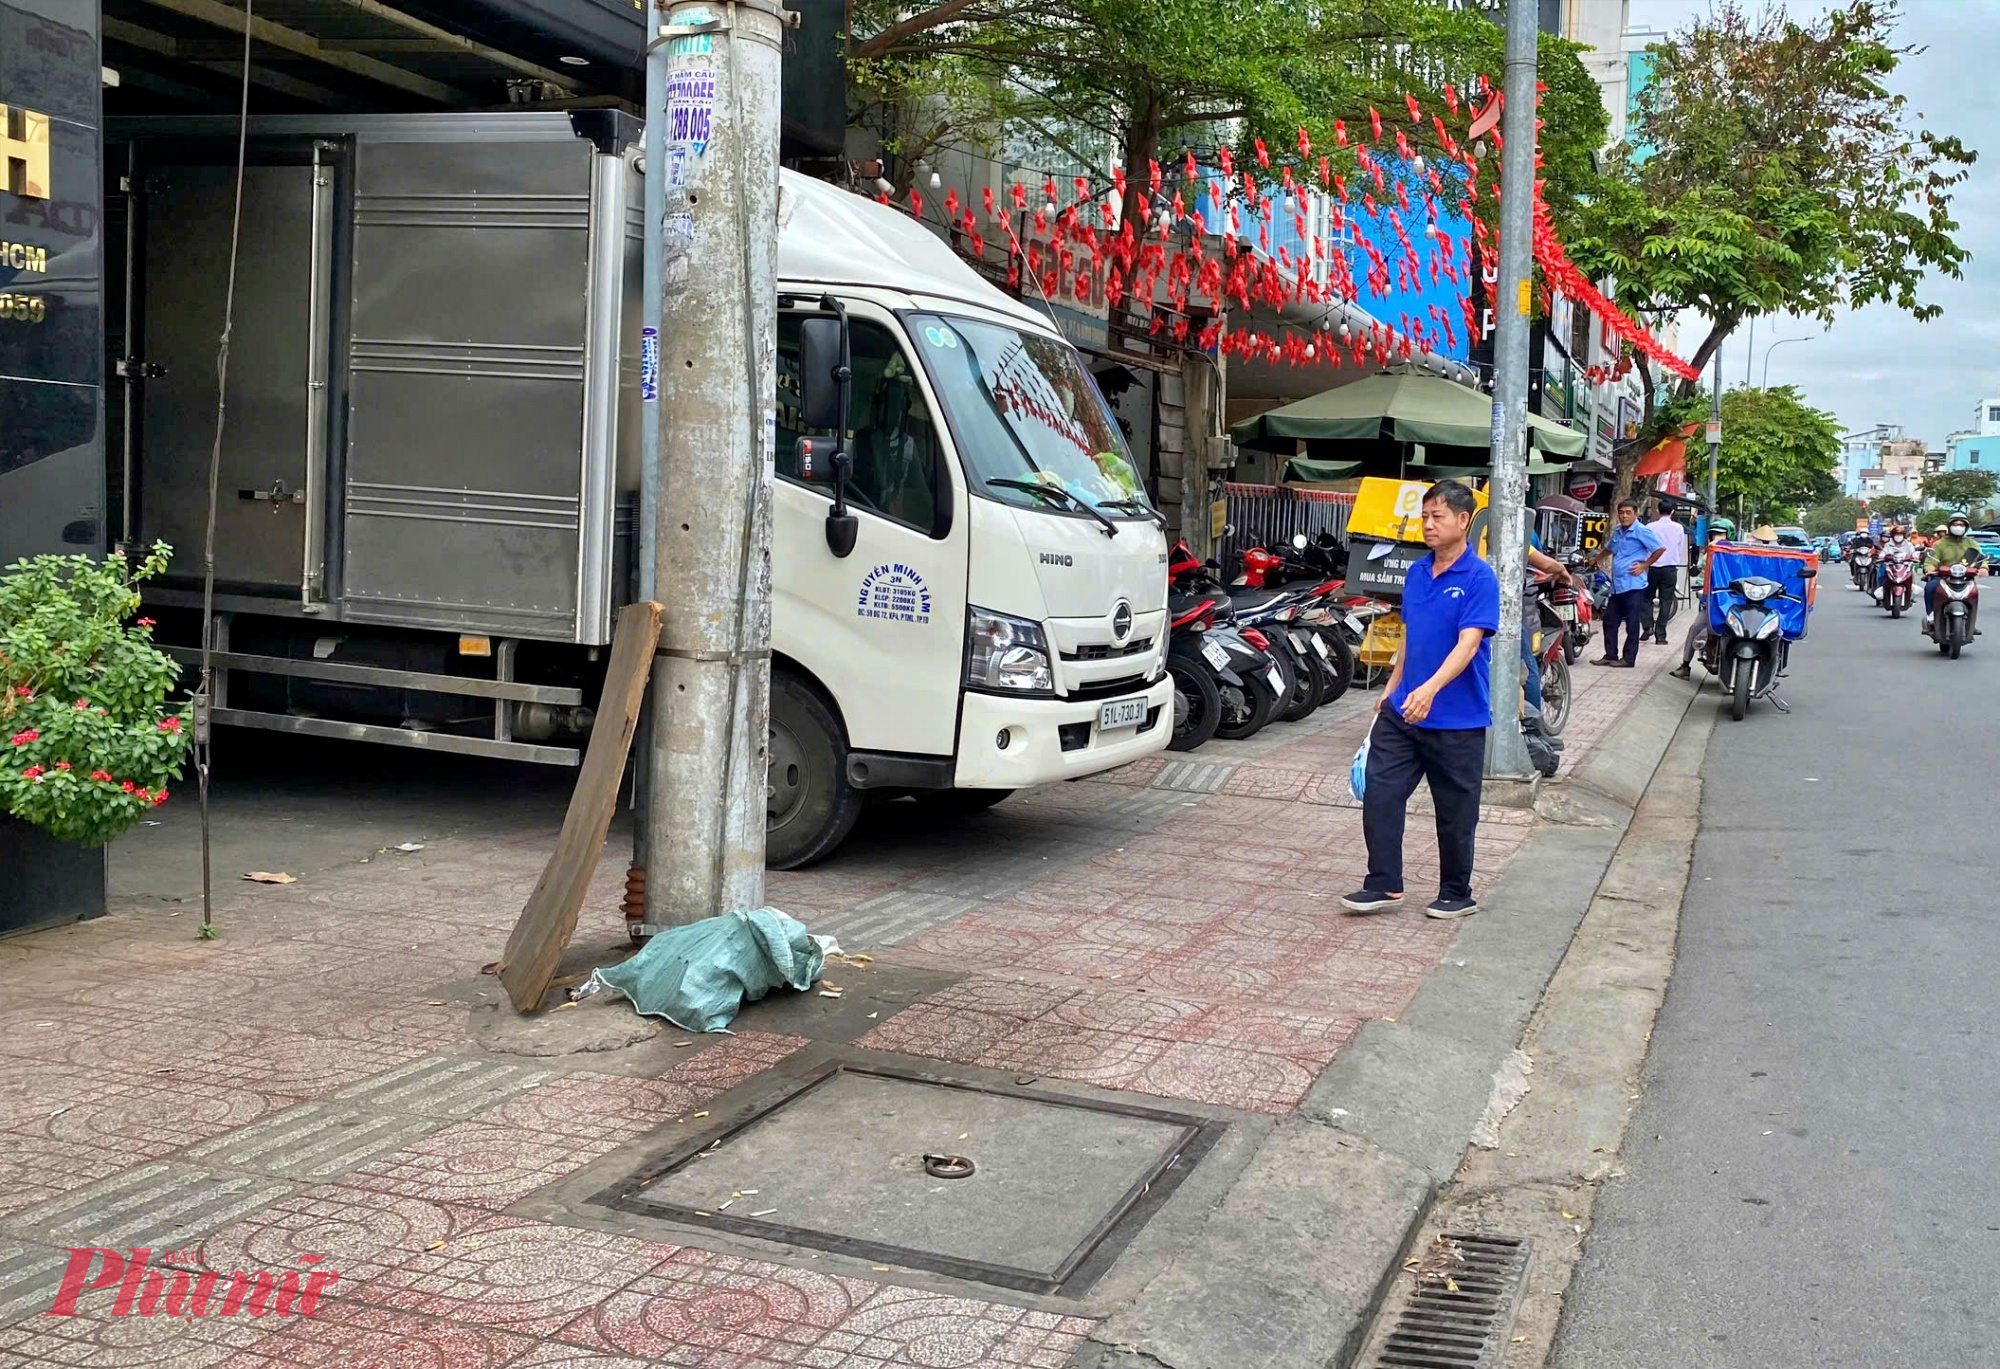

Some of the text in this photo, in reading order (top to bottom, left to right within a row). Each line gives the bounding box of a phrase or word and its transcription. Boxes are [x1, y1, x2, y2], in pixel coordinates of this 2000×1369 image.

[1039, 553, 1073, 567] HINO
[893, 563, 923, 586] MINH
[1359, 572, 1375, 582] MUA
[1104, 702, 1144, 726] 51L-730.31
